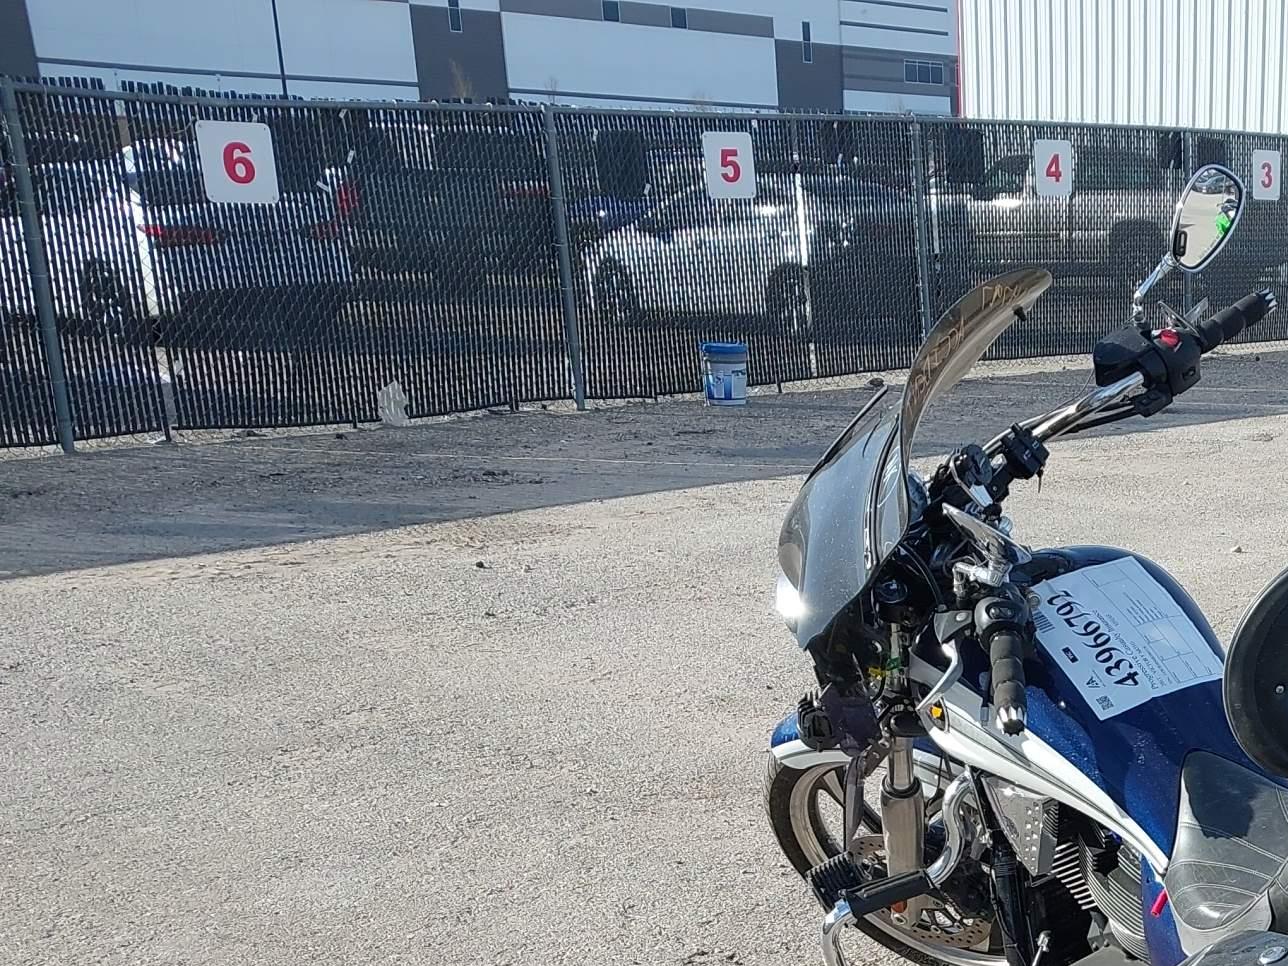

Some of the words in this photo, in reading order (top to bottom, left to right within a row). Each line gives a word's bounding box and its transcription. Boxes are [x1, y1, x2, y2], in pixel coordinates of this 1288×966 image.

[223, 142, 256, 184] 6
[721, 149, 741, 183] 5
[1046, 154, 1062, 183] 4
[1261, 162, 1273, 188] 3
[1047, 590, 1138, 685] 43966792
